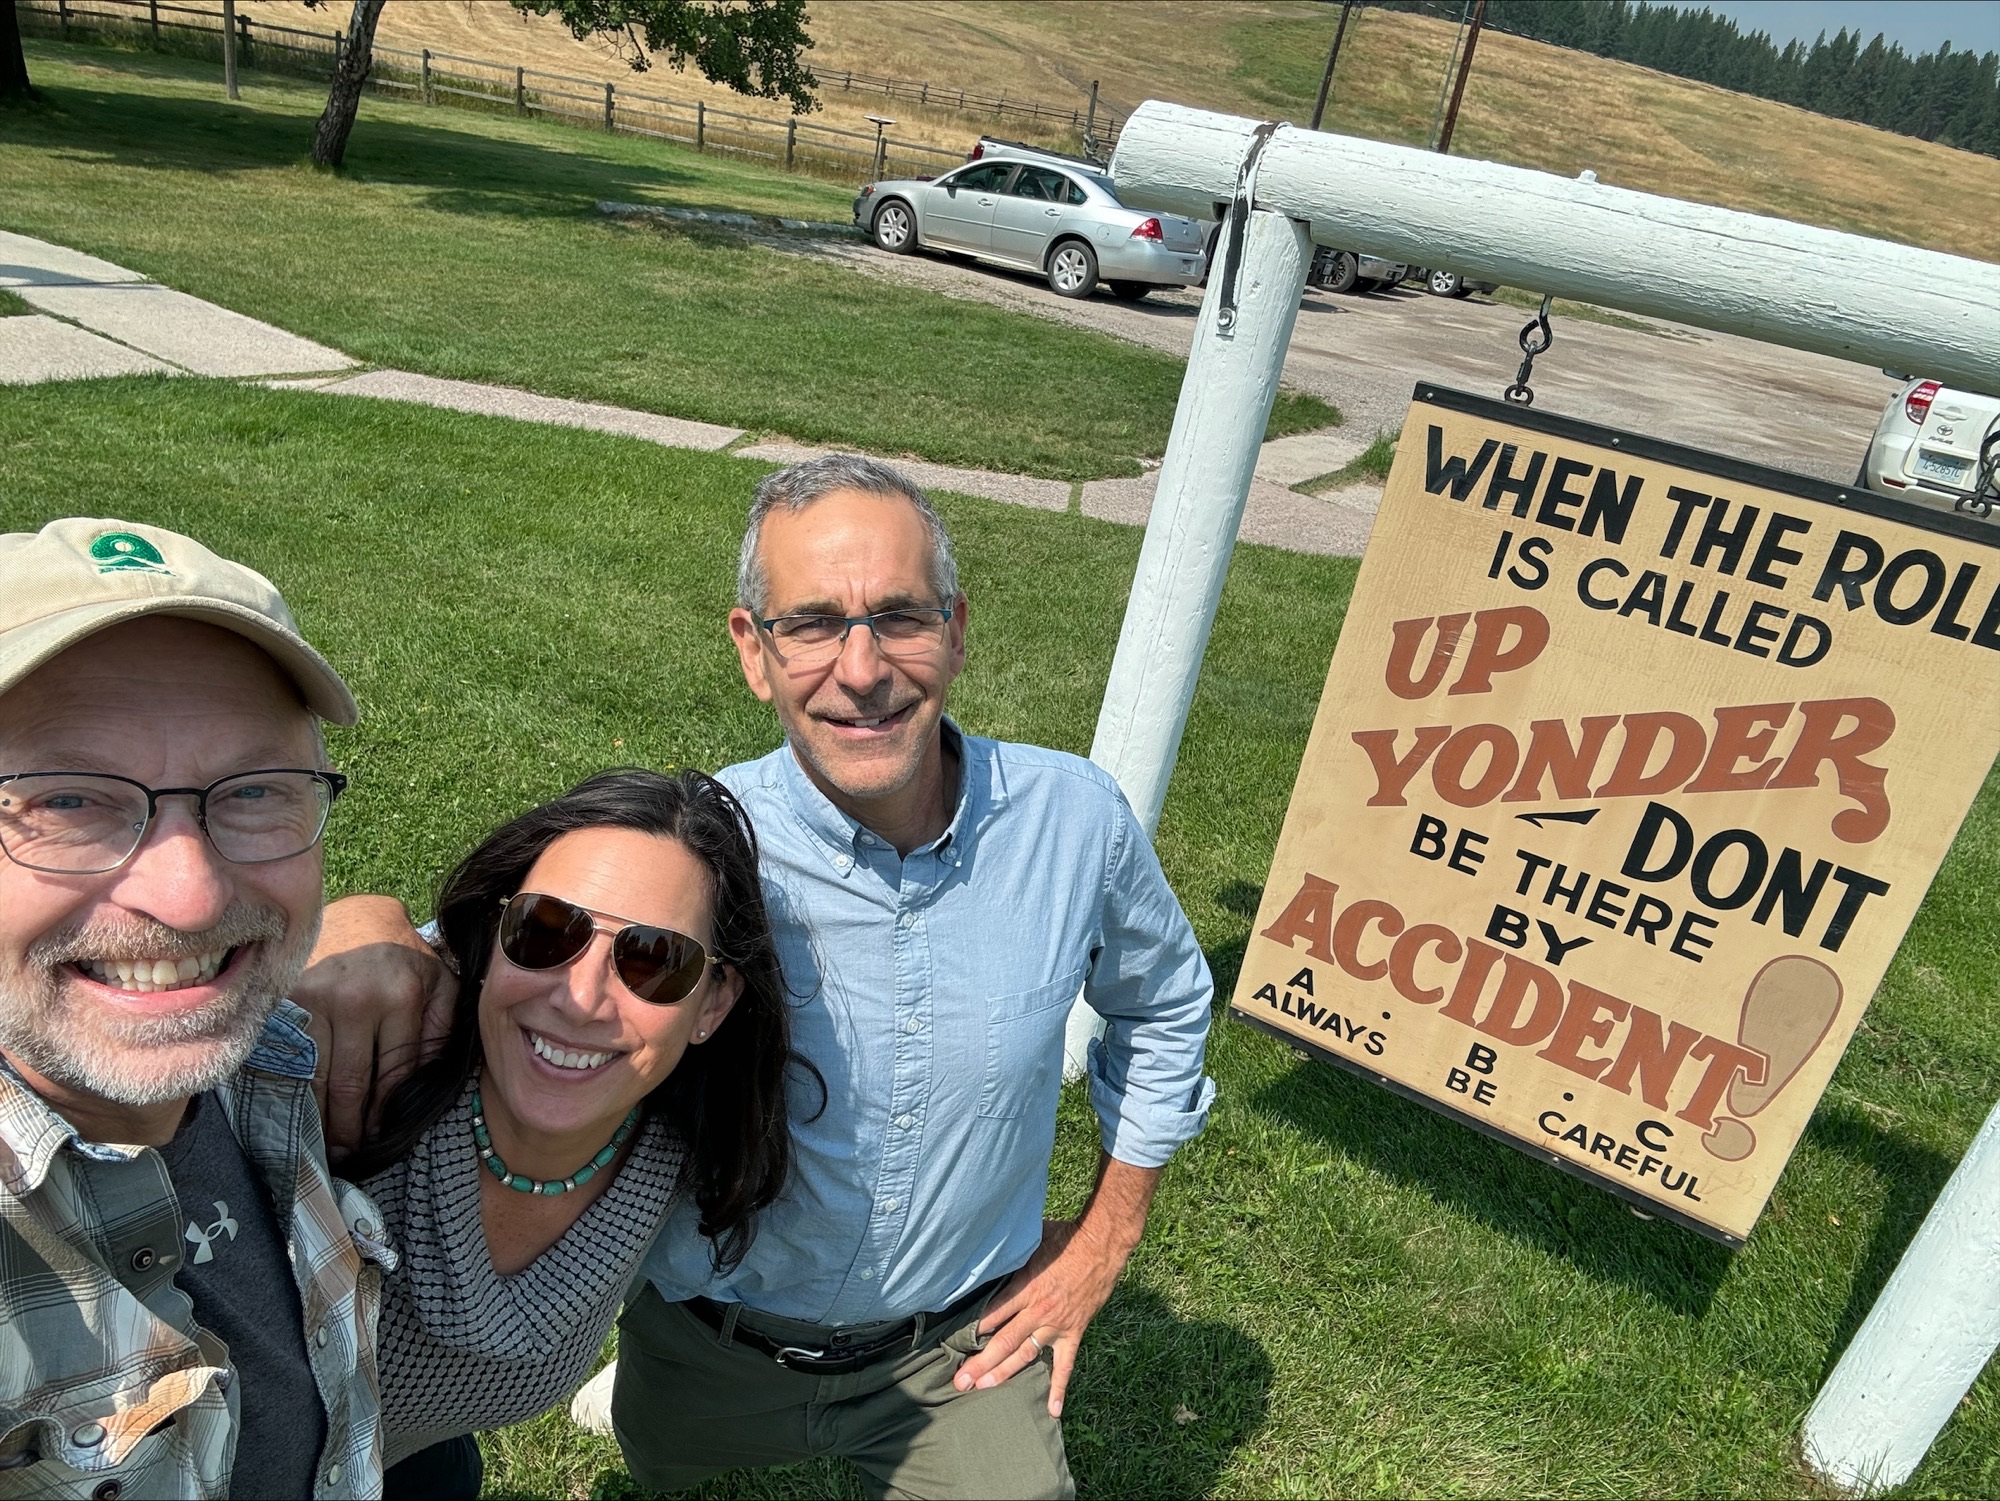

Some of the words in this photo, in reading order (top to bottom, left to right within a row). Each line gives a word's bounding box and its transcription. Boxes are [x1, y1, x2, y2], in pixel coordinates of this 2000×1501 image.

[1424, 424, 1645, 545] WHEN
[1659, 485, 1813, 590] THE
[1811, 529, 2000, 652] ROLL
[1487, 530, 1554, 591] IS
[1577, 557, 1833, 668] CALLED
[1384, 605, 1550, 700] UP
[1351, 697, 1896, 843] YONDER
[1409, 813, 1490, 877] BE
[1515, 848, 1720, 964] THERE
[1484, 903, 1594, 967] BY
[1620, 801, 1891, 953] DONT
[1251, 982, 1388, 1056] ALWAYS
[1260, 872, 1844, 1162] ACCIDENT!
[1286, 967, 1315, 997] A
[1464, 1042, 1498, 1075] B
[1635, 1120, 1675, 1153] C
[1445, 1067, 1498, 1106] BE
[1538, 1110, 1702, 1202] CAREFUL
